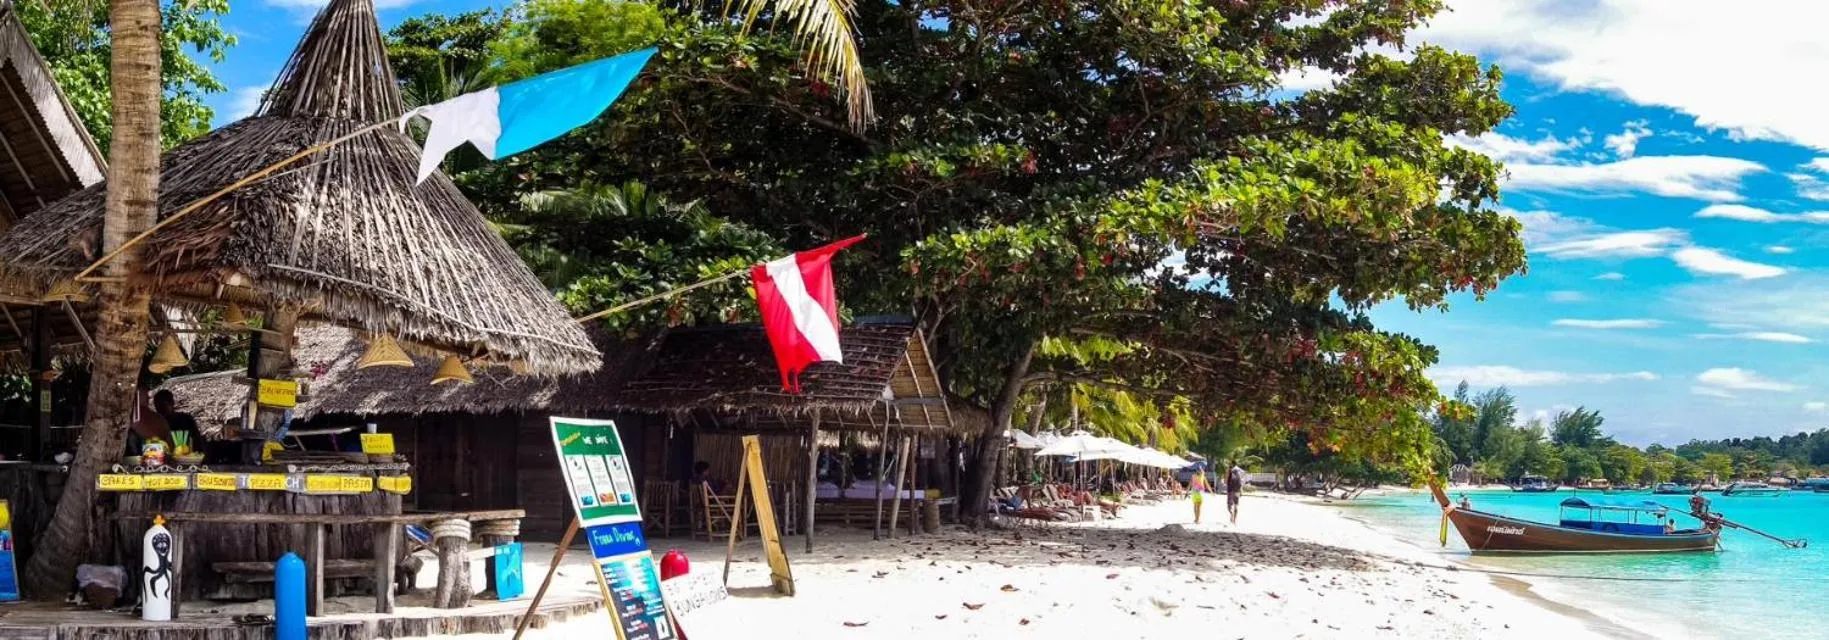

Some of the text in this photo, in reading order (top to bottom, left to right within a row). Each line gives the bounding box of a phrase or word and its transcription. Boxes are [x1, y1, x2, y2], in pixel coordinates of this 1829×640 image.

[101, 475, 135, 486] CAKES
[251, 477, 282, 488] PIZZA
[343, 477, 371, 489] PASTA
